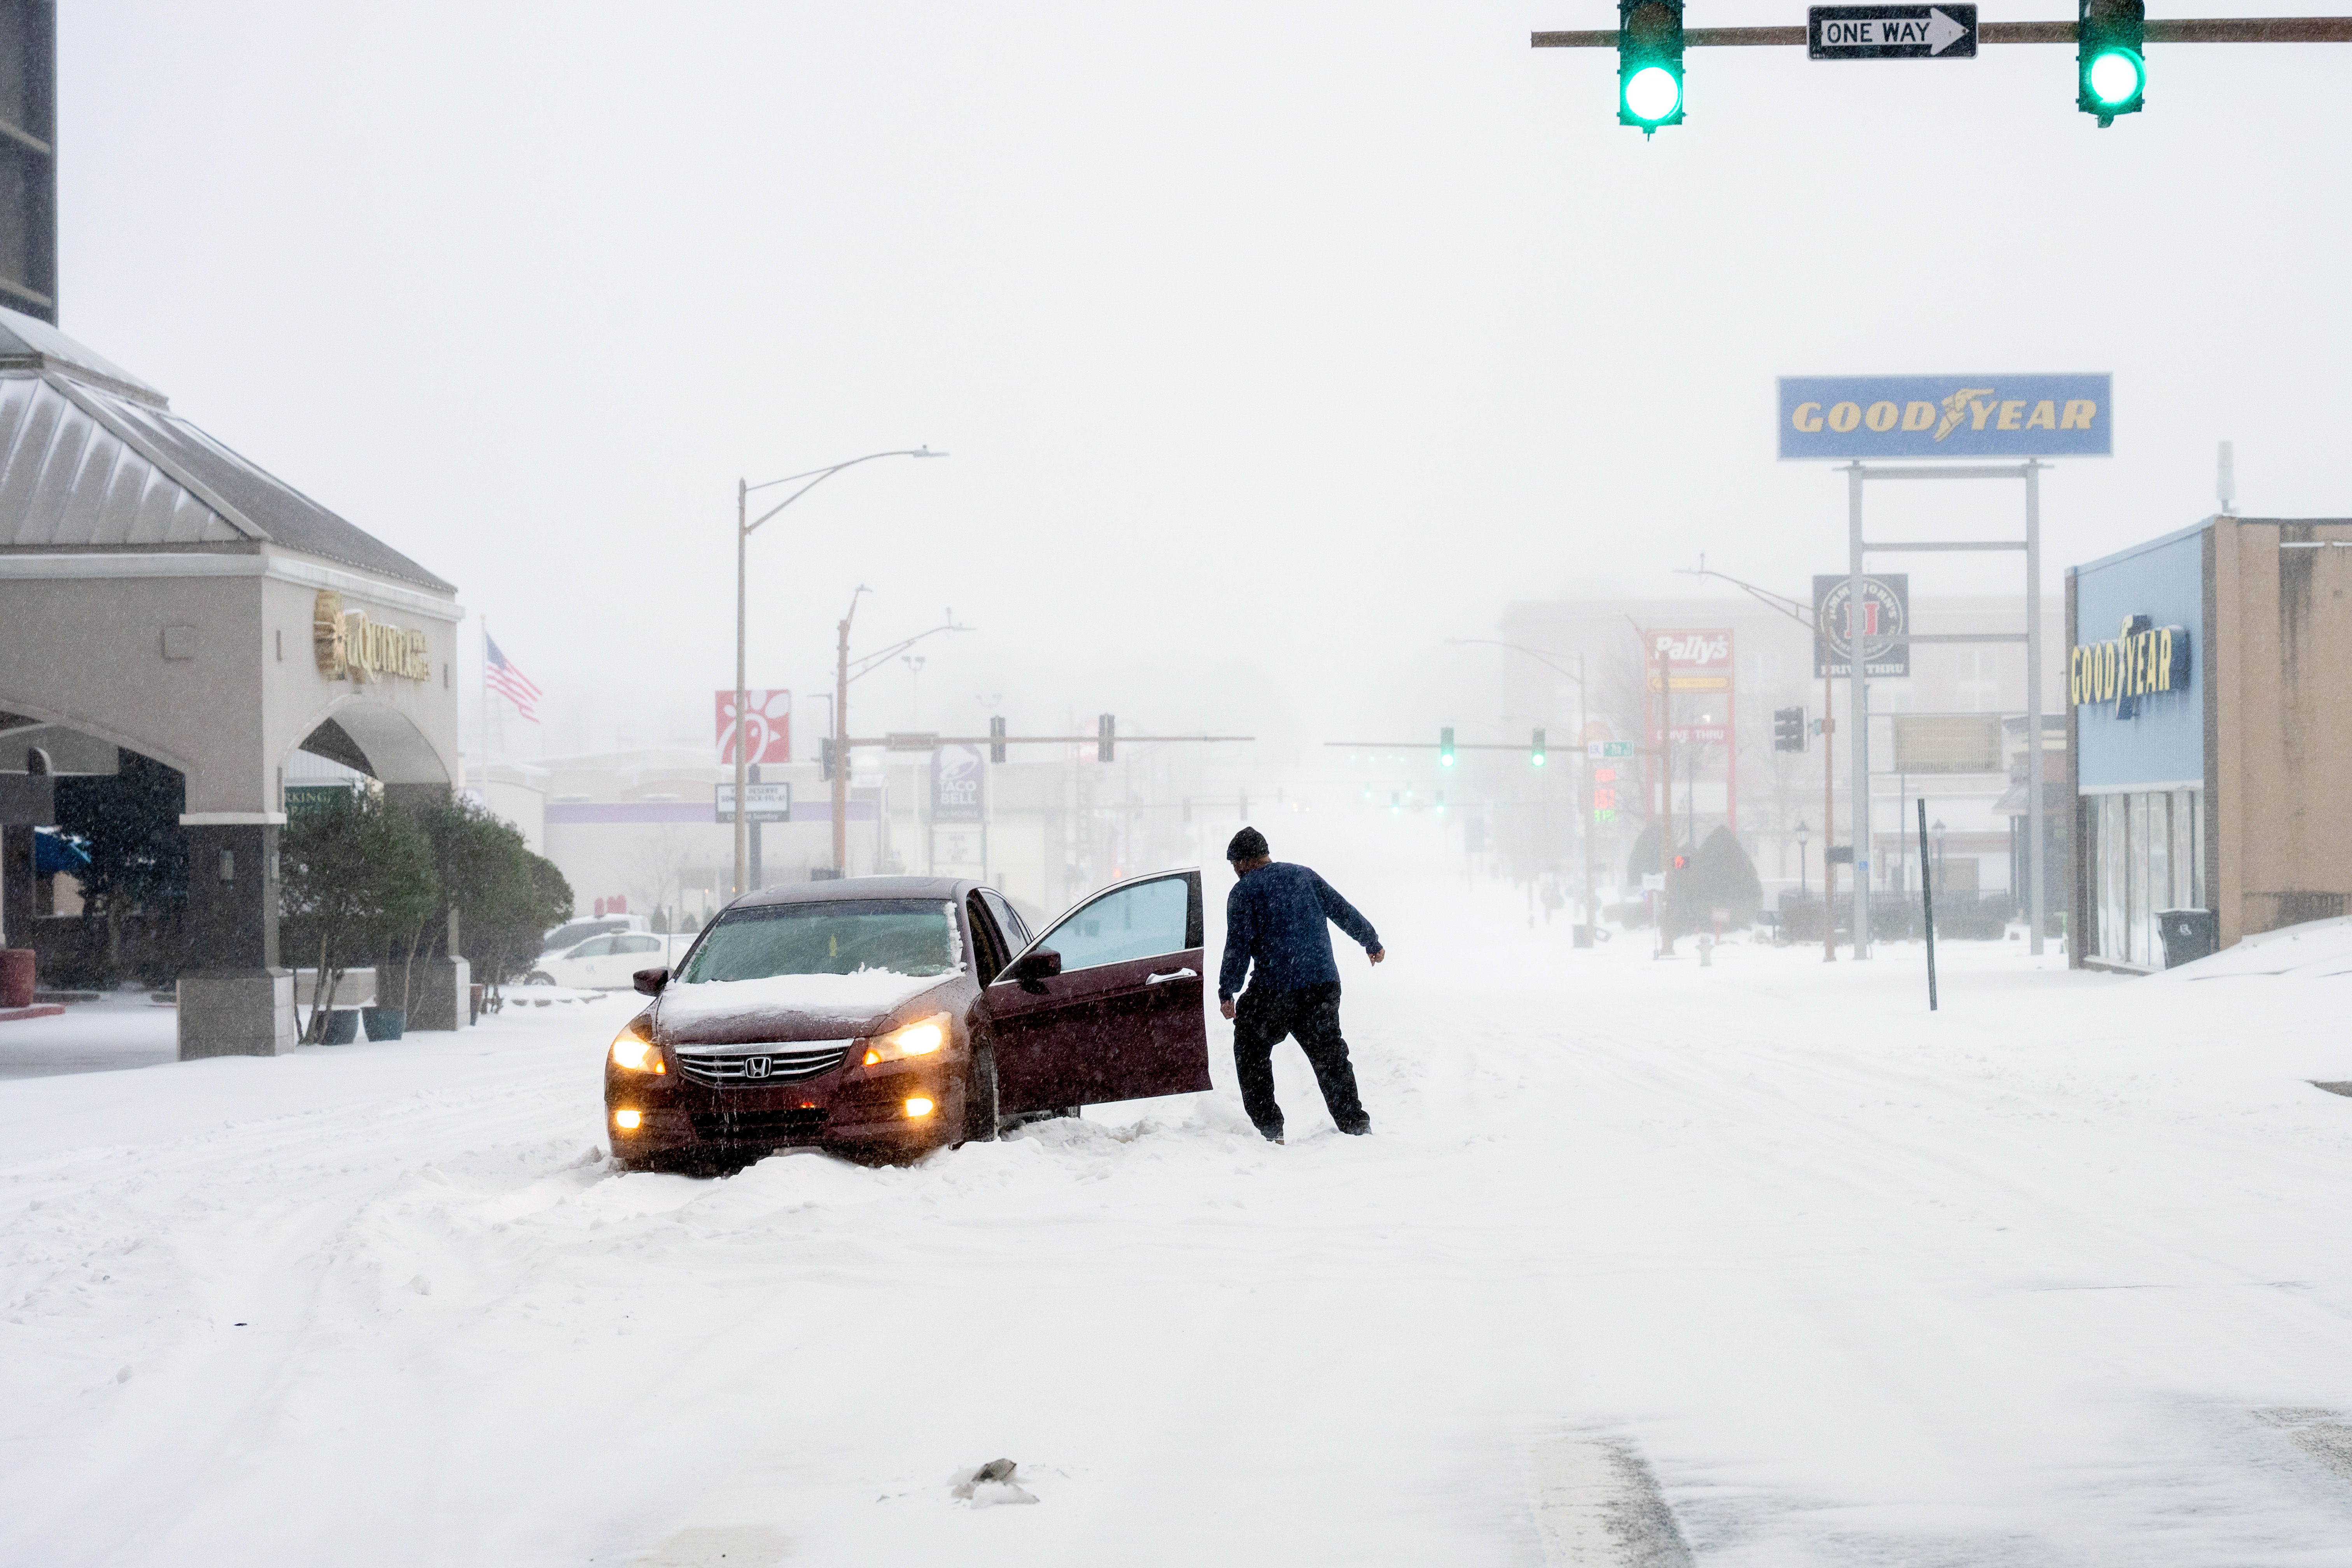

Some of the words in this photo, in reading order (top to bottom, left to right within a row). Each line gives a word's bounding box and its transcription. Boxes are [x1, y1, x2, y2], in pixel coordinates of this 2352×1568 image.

[1827, 23, 1872, 44] ONE
[1882, 22, 1930, 43] WAY
[1791, 399, 2097, 433] GOODYEAR
[1866, 664, 1904, 674] THRU
[2071, 628, 2172, 705] GOODYEAR
[1696, 730, 1724, 739] THRU
[939, 780, 977, 792] TACO
[941, 792, 977, 805] BELL
